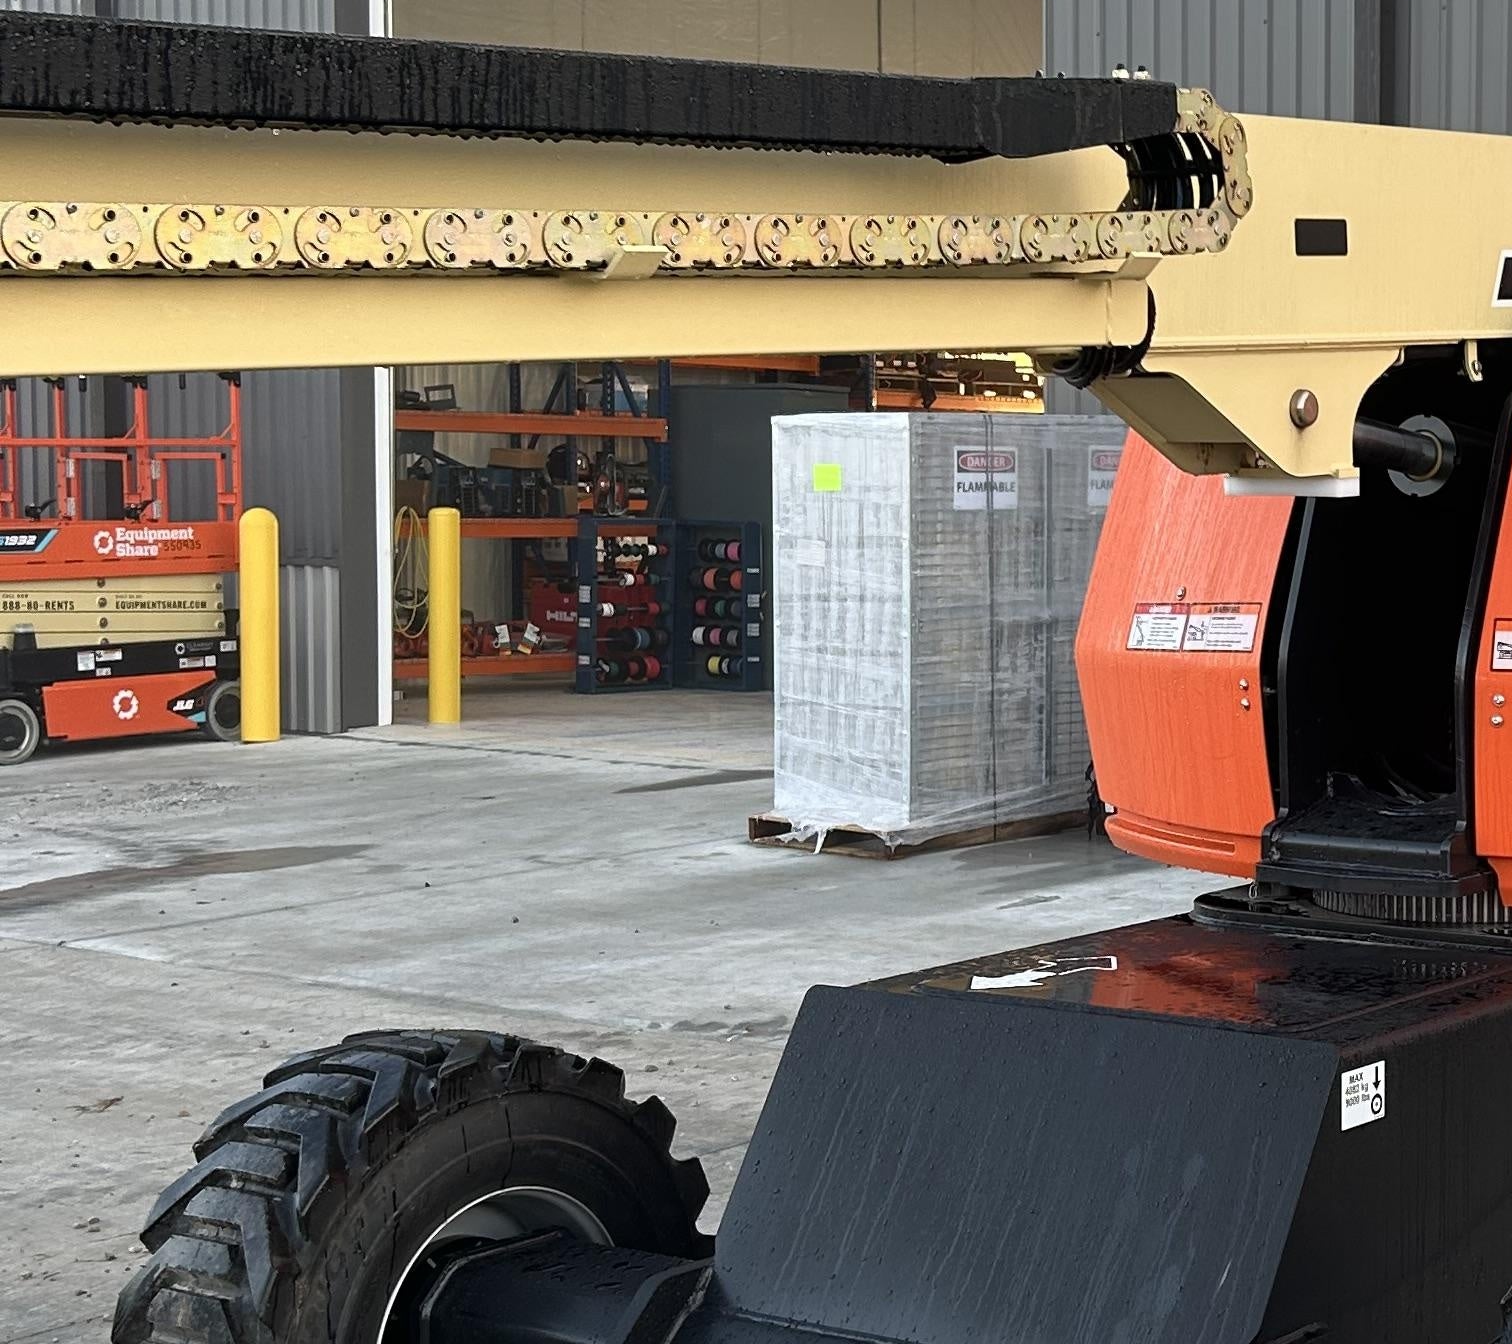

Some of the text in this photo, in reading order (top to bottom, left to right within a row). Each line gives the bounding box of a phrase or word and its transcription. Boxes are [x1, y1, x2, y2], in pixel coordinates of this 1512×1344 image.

[115, 527, 194, 542] Equipment
[116, 542, 159, 556] Share
[115, 601, 207, 610] EQUIPMENTSHARE.COM
[1349, 1072, 1363, 1084] MAX
